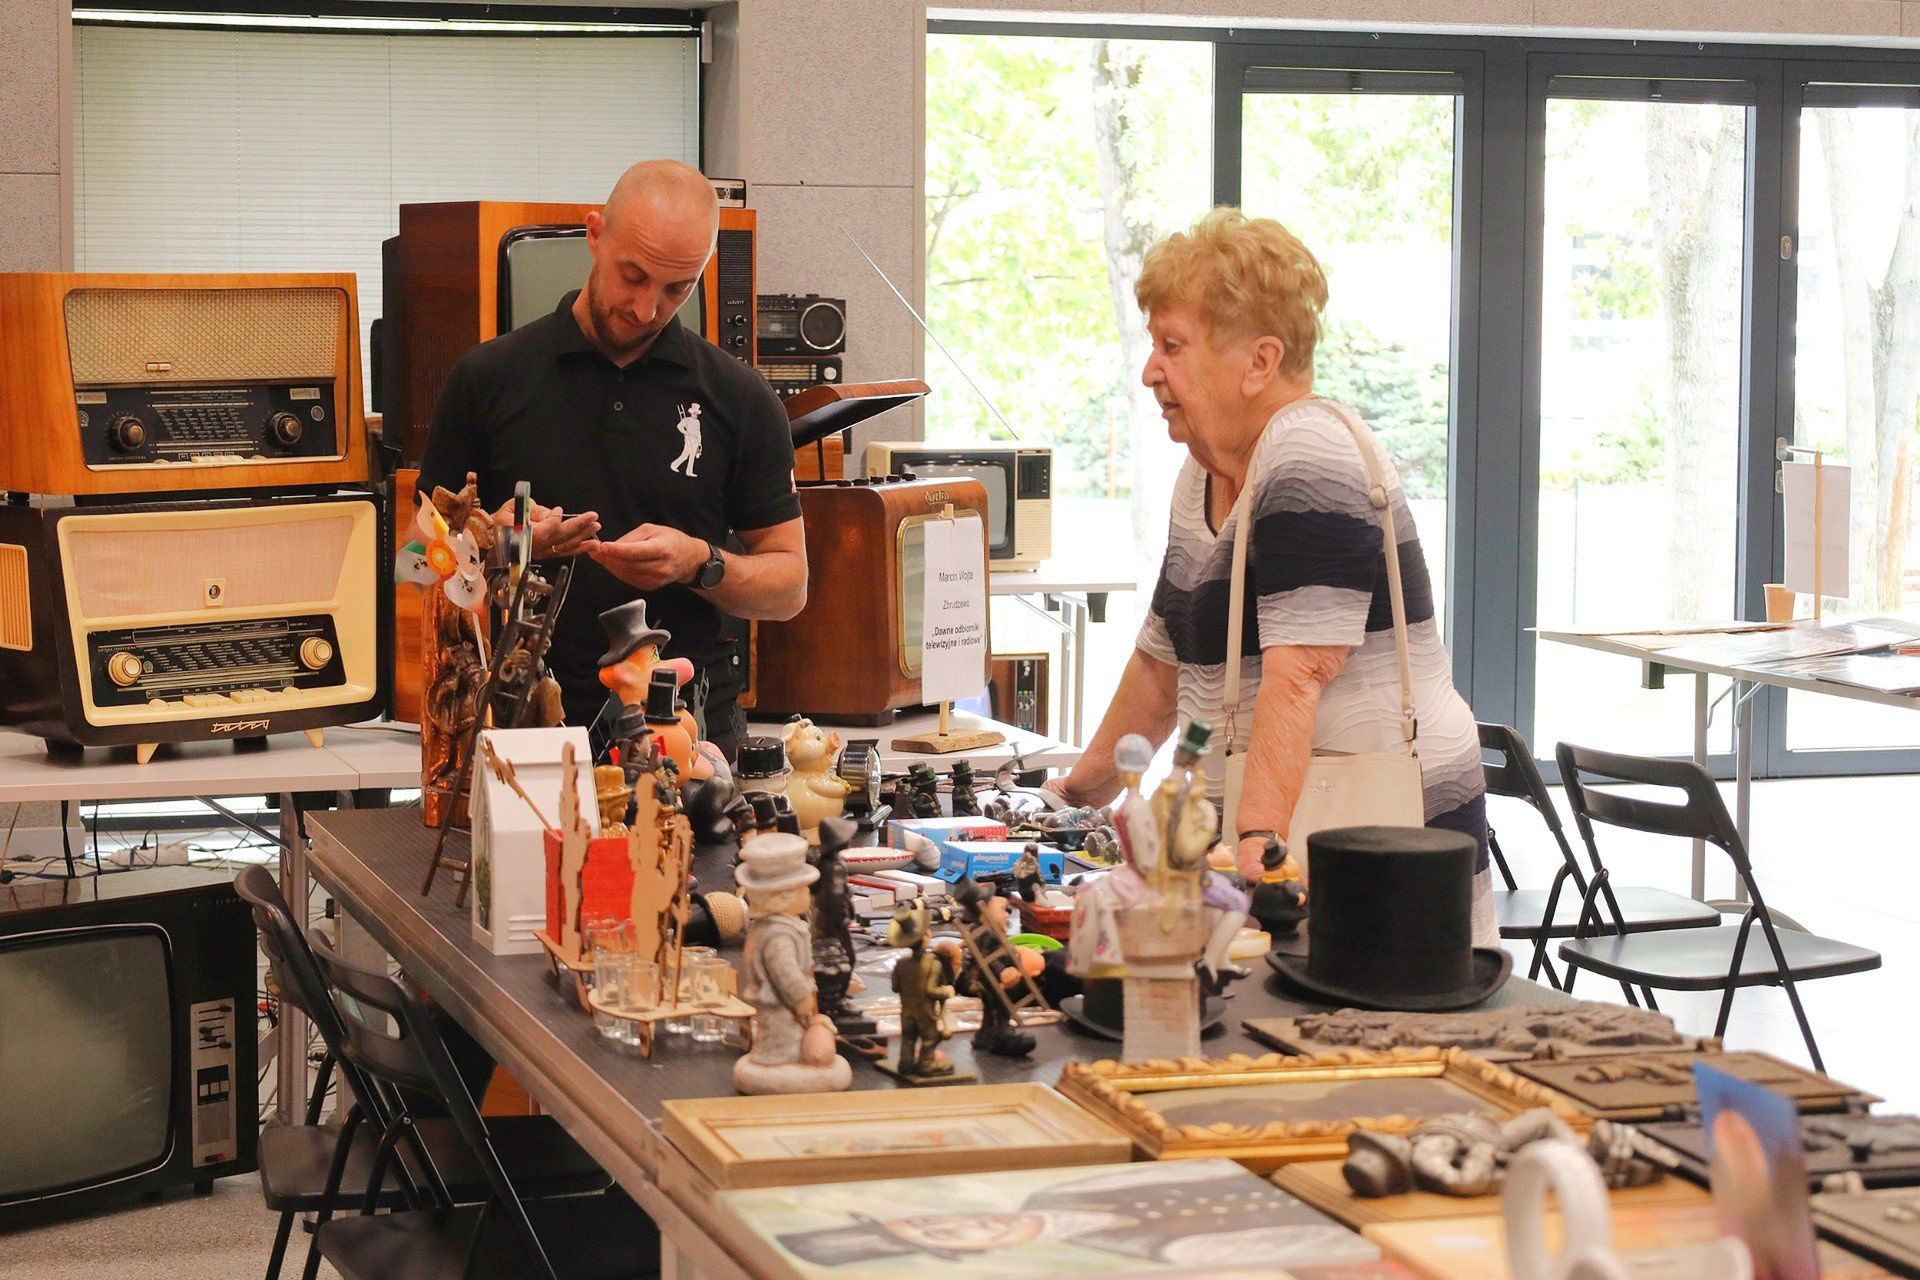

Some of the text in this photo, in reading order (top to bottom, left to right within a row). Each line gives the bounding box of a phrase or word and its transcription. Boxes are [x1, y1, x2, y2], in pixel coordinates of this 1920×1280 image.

[938, 572, 957, 582] Marcin
[955, 623, 979, 634] odbiorniki
[926, 639, 957, 651] telewizyjne
[973, 853, 1010, 863] playmobil
